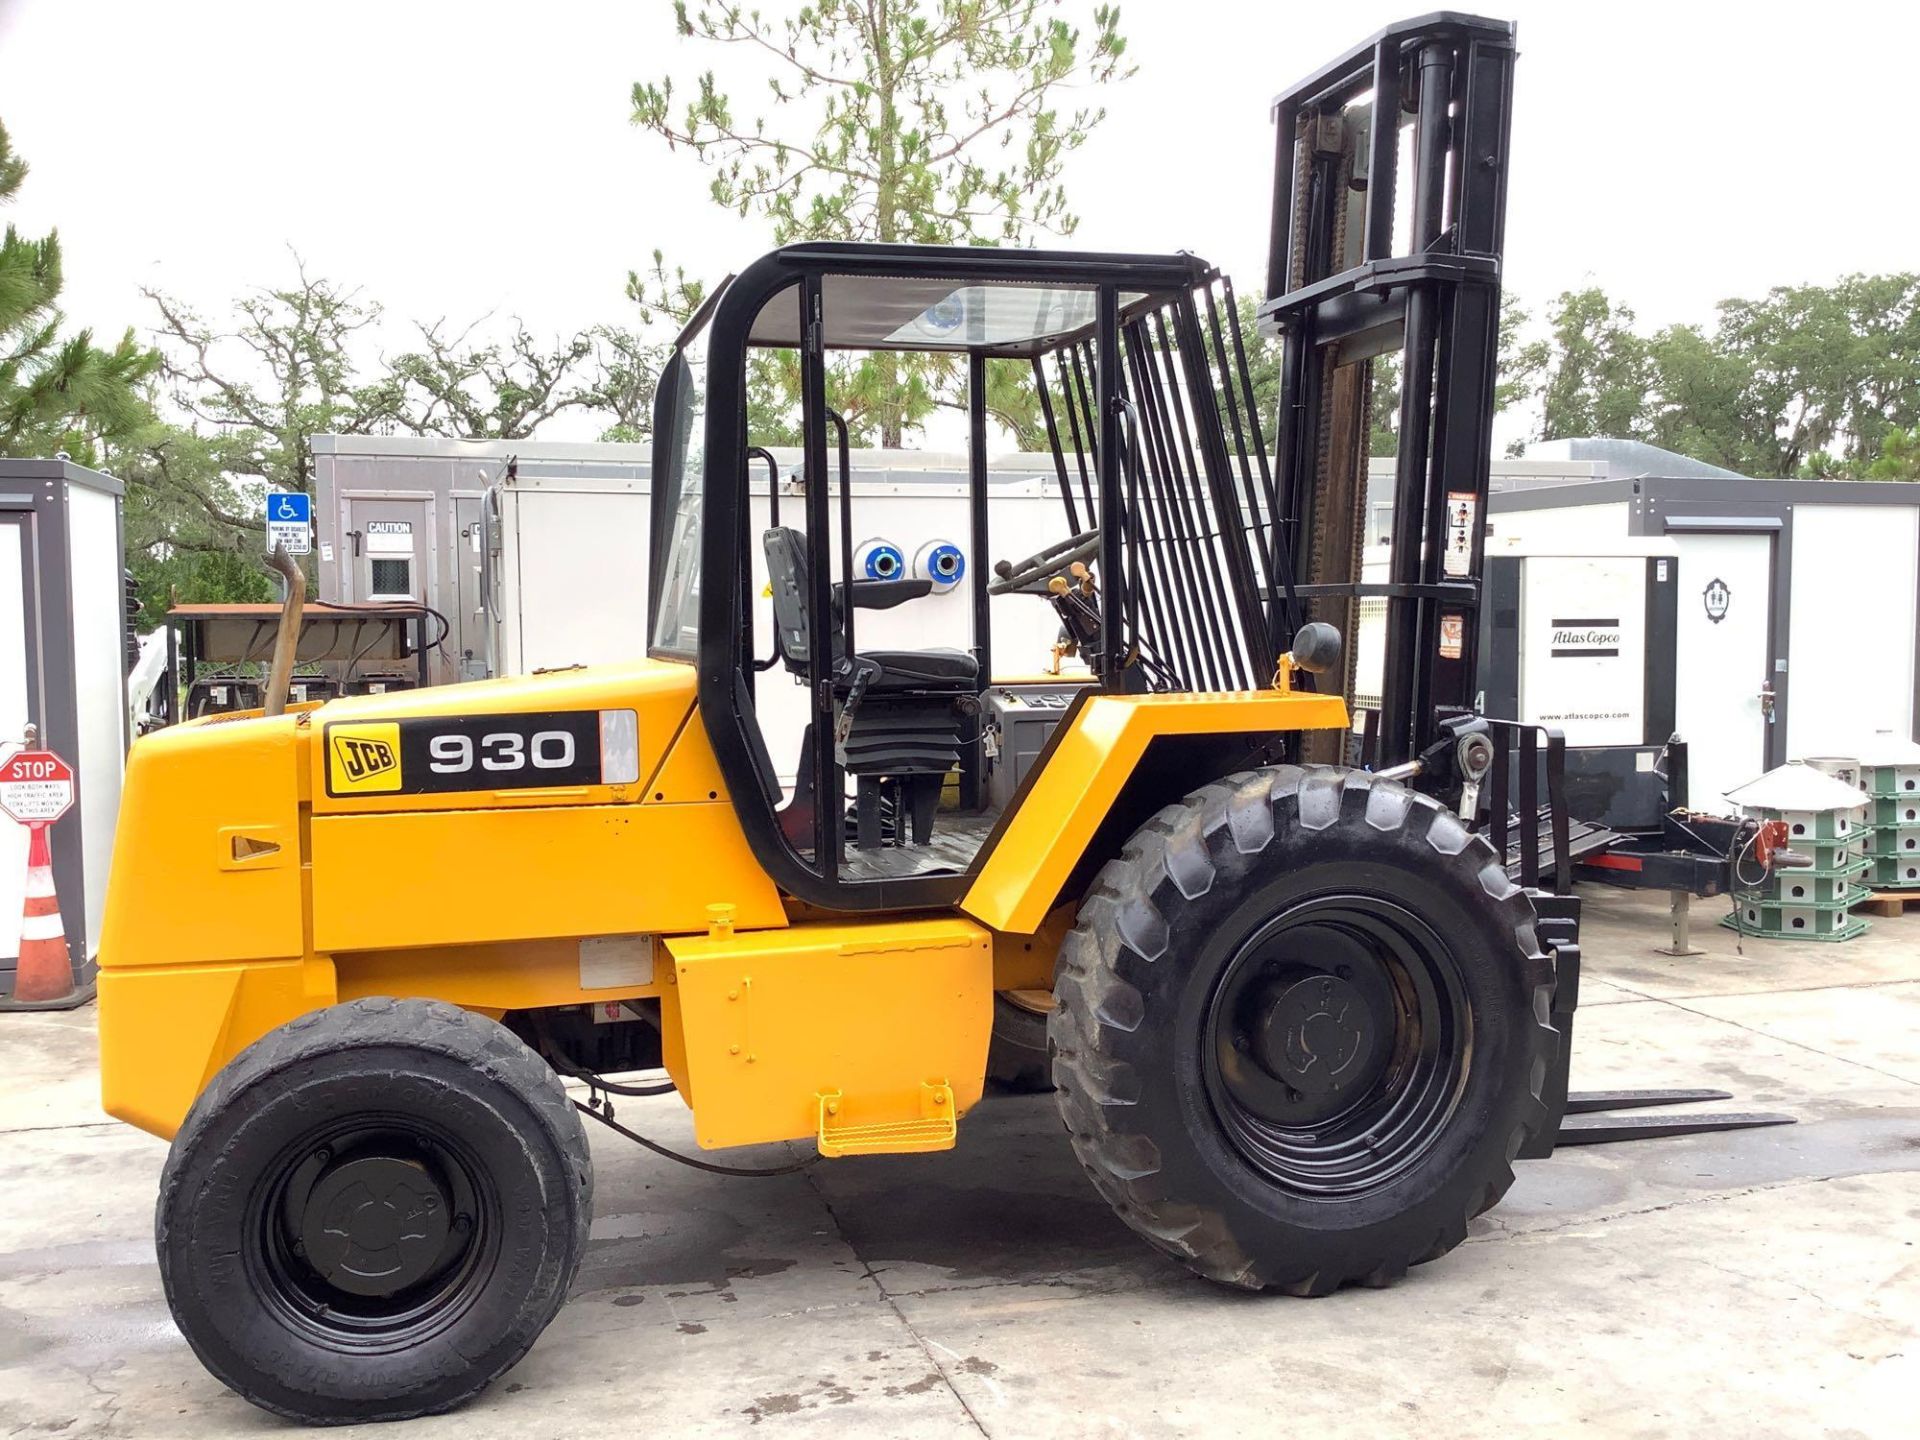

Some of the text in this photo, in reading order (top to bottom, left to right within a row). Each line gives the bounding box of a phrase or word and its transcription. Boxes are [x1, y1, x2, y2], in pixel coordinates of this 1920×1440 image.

[368, 522, 411, 534] CAUTION
[1551, 630, 1620, 646] Atlas Copco
[1539, 712, 1630, 720] www.atlascopco.com
[345, 741, 393, 777] JCB
[429, 730, 576, 774] 930
[12, 761, 57, 779] STOP
